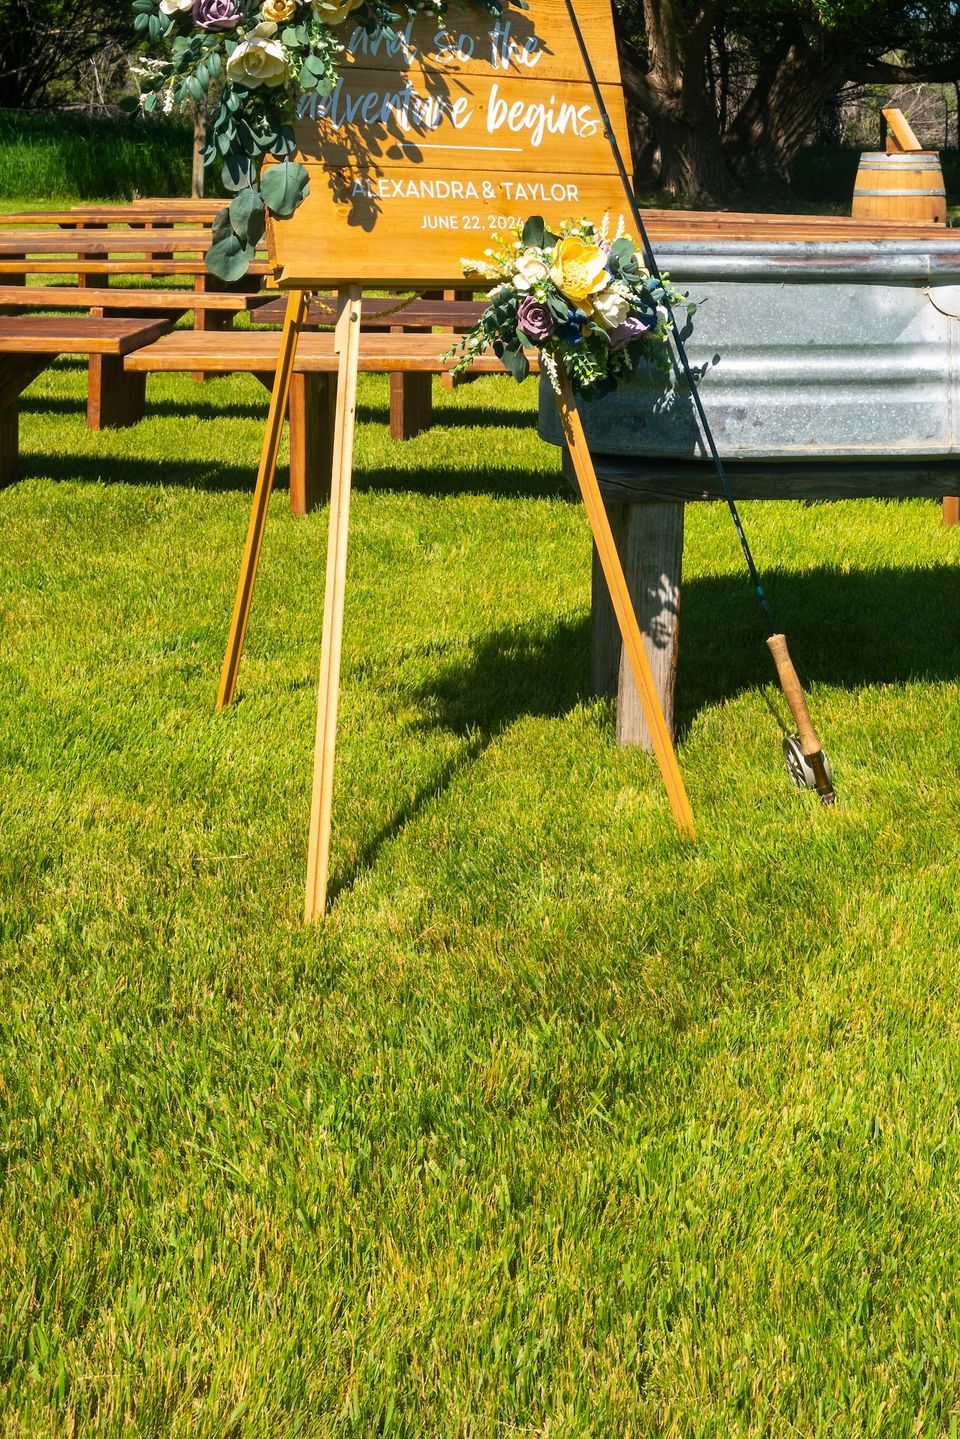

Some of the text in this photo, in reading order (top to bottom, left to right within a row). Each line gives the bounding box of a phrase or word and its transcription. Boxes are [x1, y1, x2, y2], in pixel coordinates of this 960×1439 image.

[348, 17, 544, 70] and so the
[296, 77, 601, 148] adventure begins
[351, 178, 580, 202] ALEXANDRA & TAYLOR
[420, 215, 525, 231] JUNE 22, 2024
